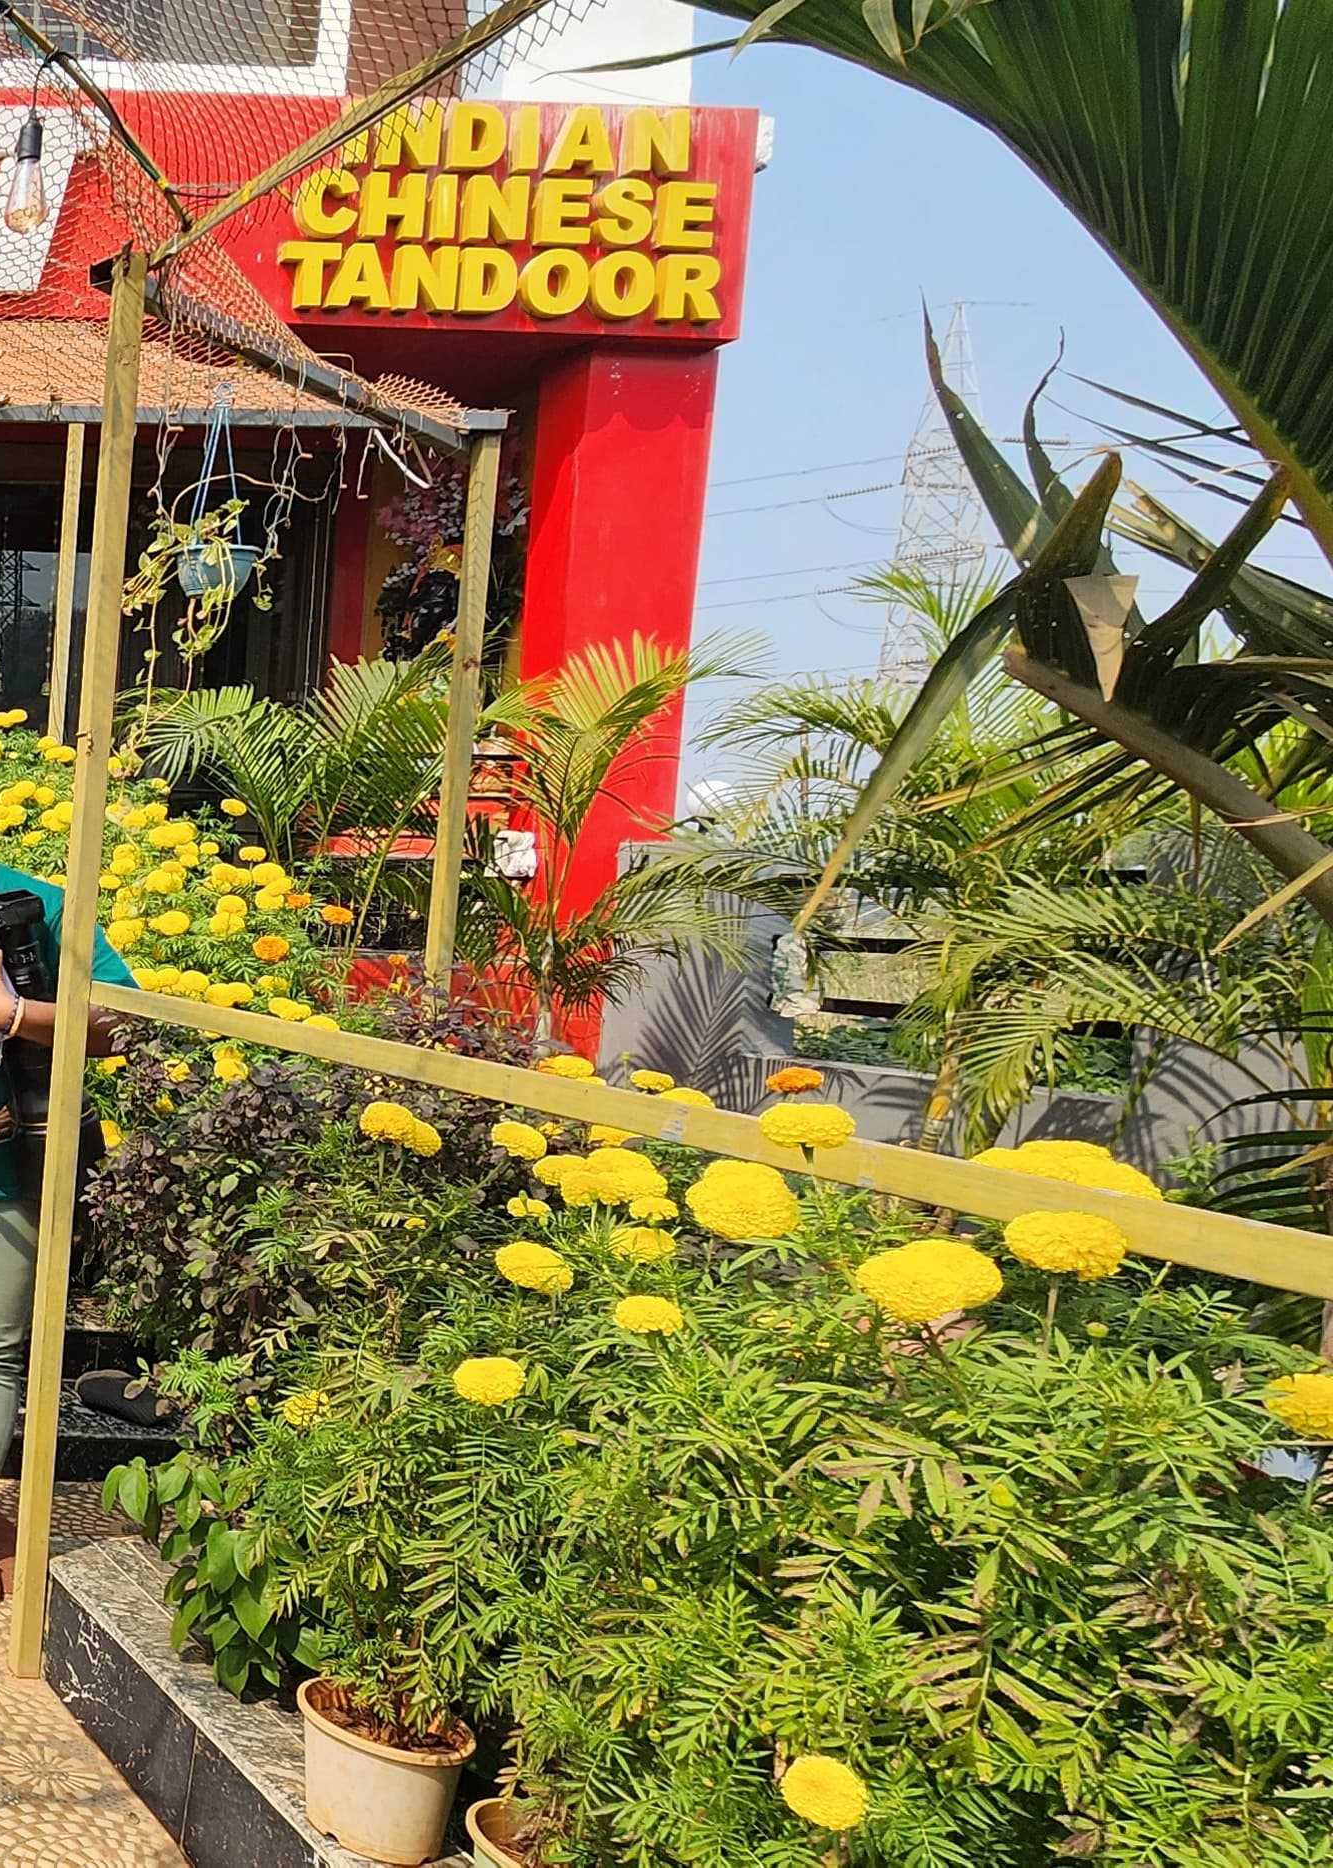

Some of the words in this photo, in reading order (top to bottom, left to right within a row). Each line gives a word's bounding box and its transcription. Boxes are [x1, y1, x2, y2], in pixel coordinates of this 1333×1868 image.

[341, 97, 692, 178] INDIAN
[293, 166, 718, 250] CHINESE
[278, 241, 721, 323] TANDOOR
